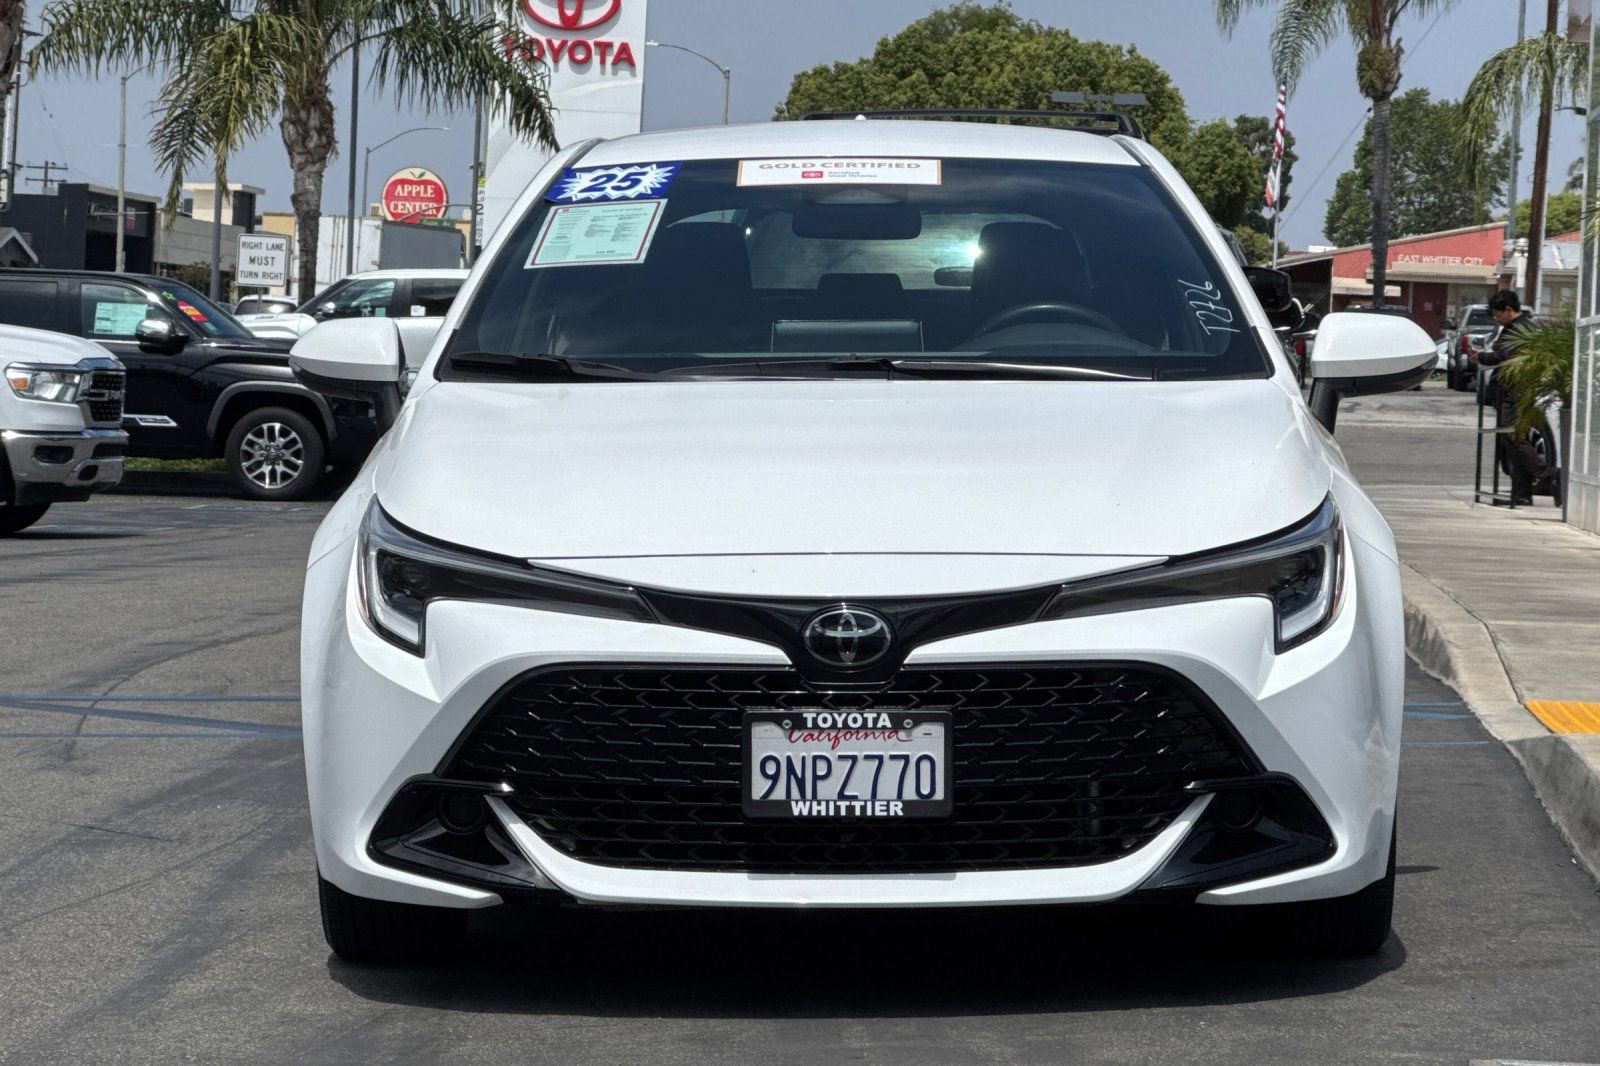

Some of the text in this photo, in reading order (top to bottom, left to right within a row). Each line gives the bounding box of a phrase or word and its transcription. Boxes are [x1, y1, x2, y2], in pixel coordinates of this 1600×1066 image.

[504, 34, 636, 66] TOYOTA
[759, 161, 921, 170] GOLD CERTIFIED
[577, 171, 650, 194] 25
[394, 184, 435, 198] APPLE
[389, 201, 438, 215] CENTER
[241, 241, 285, 252] RIGHT LANE
[249, 255, 276, 267] MUST
[1398, 254, 1484, 266] EAST WHITTIER CITY
[240, 270, 283, 281] TURN RIGHT
[803, 713, 892, 729] TOYOTA
[788, 729, 914, 750] California
[759, 754, 936, 800] 9NPZ770
[791, 801, 904, 817] WHITTIER
